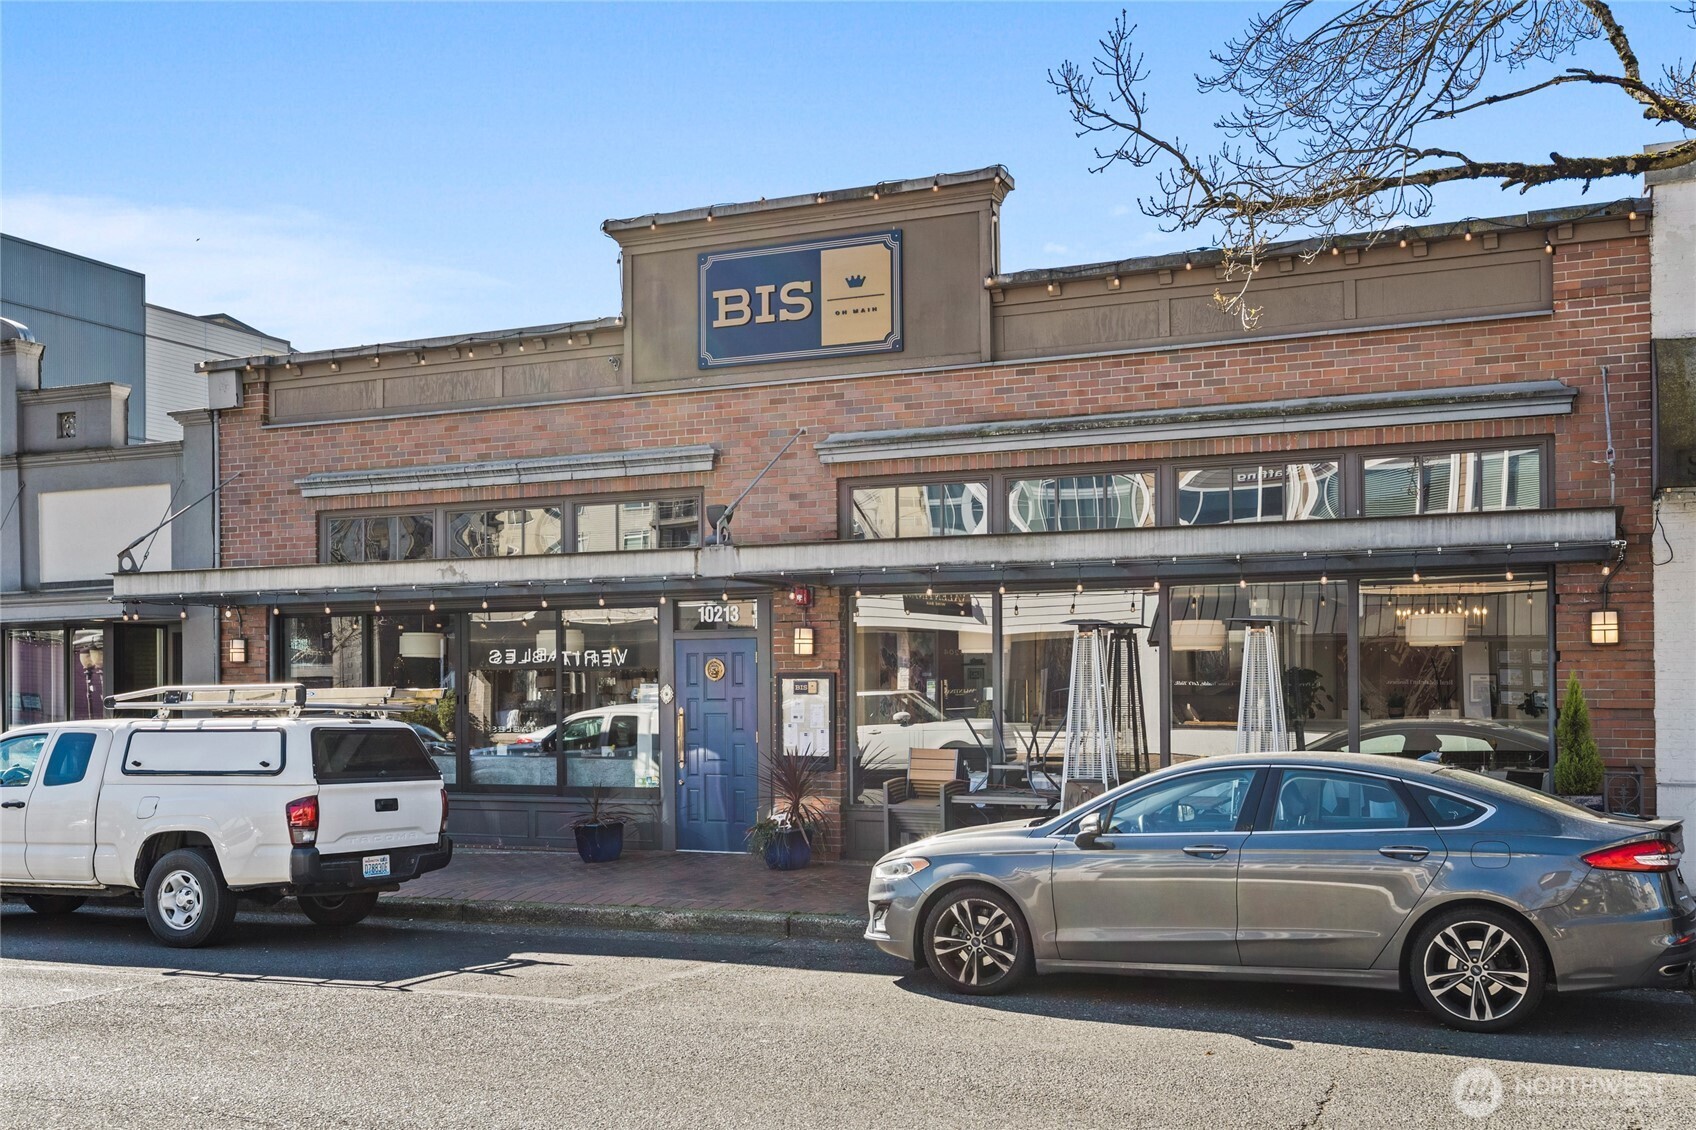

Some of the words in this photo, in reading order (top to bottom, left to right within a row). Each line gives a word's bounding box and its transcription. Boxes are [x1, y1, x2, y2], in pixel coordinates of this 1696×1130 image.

[712, 280, 813, 328] BIS
[853, 306, 878, 315] MAIN
[698, 605, 740, 623] 10213
[346, 832, 418, 844] TACOMA
